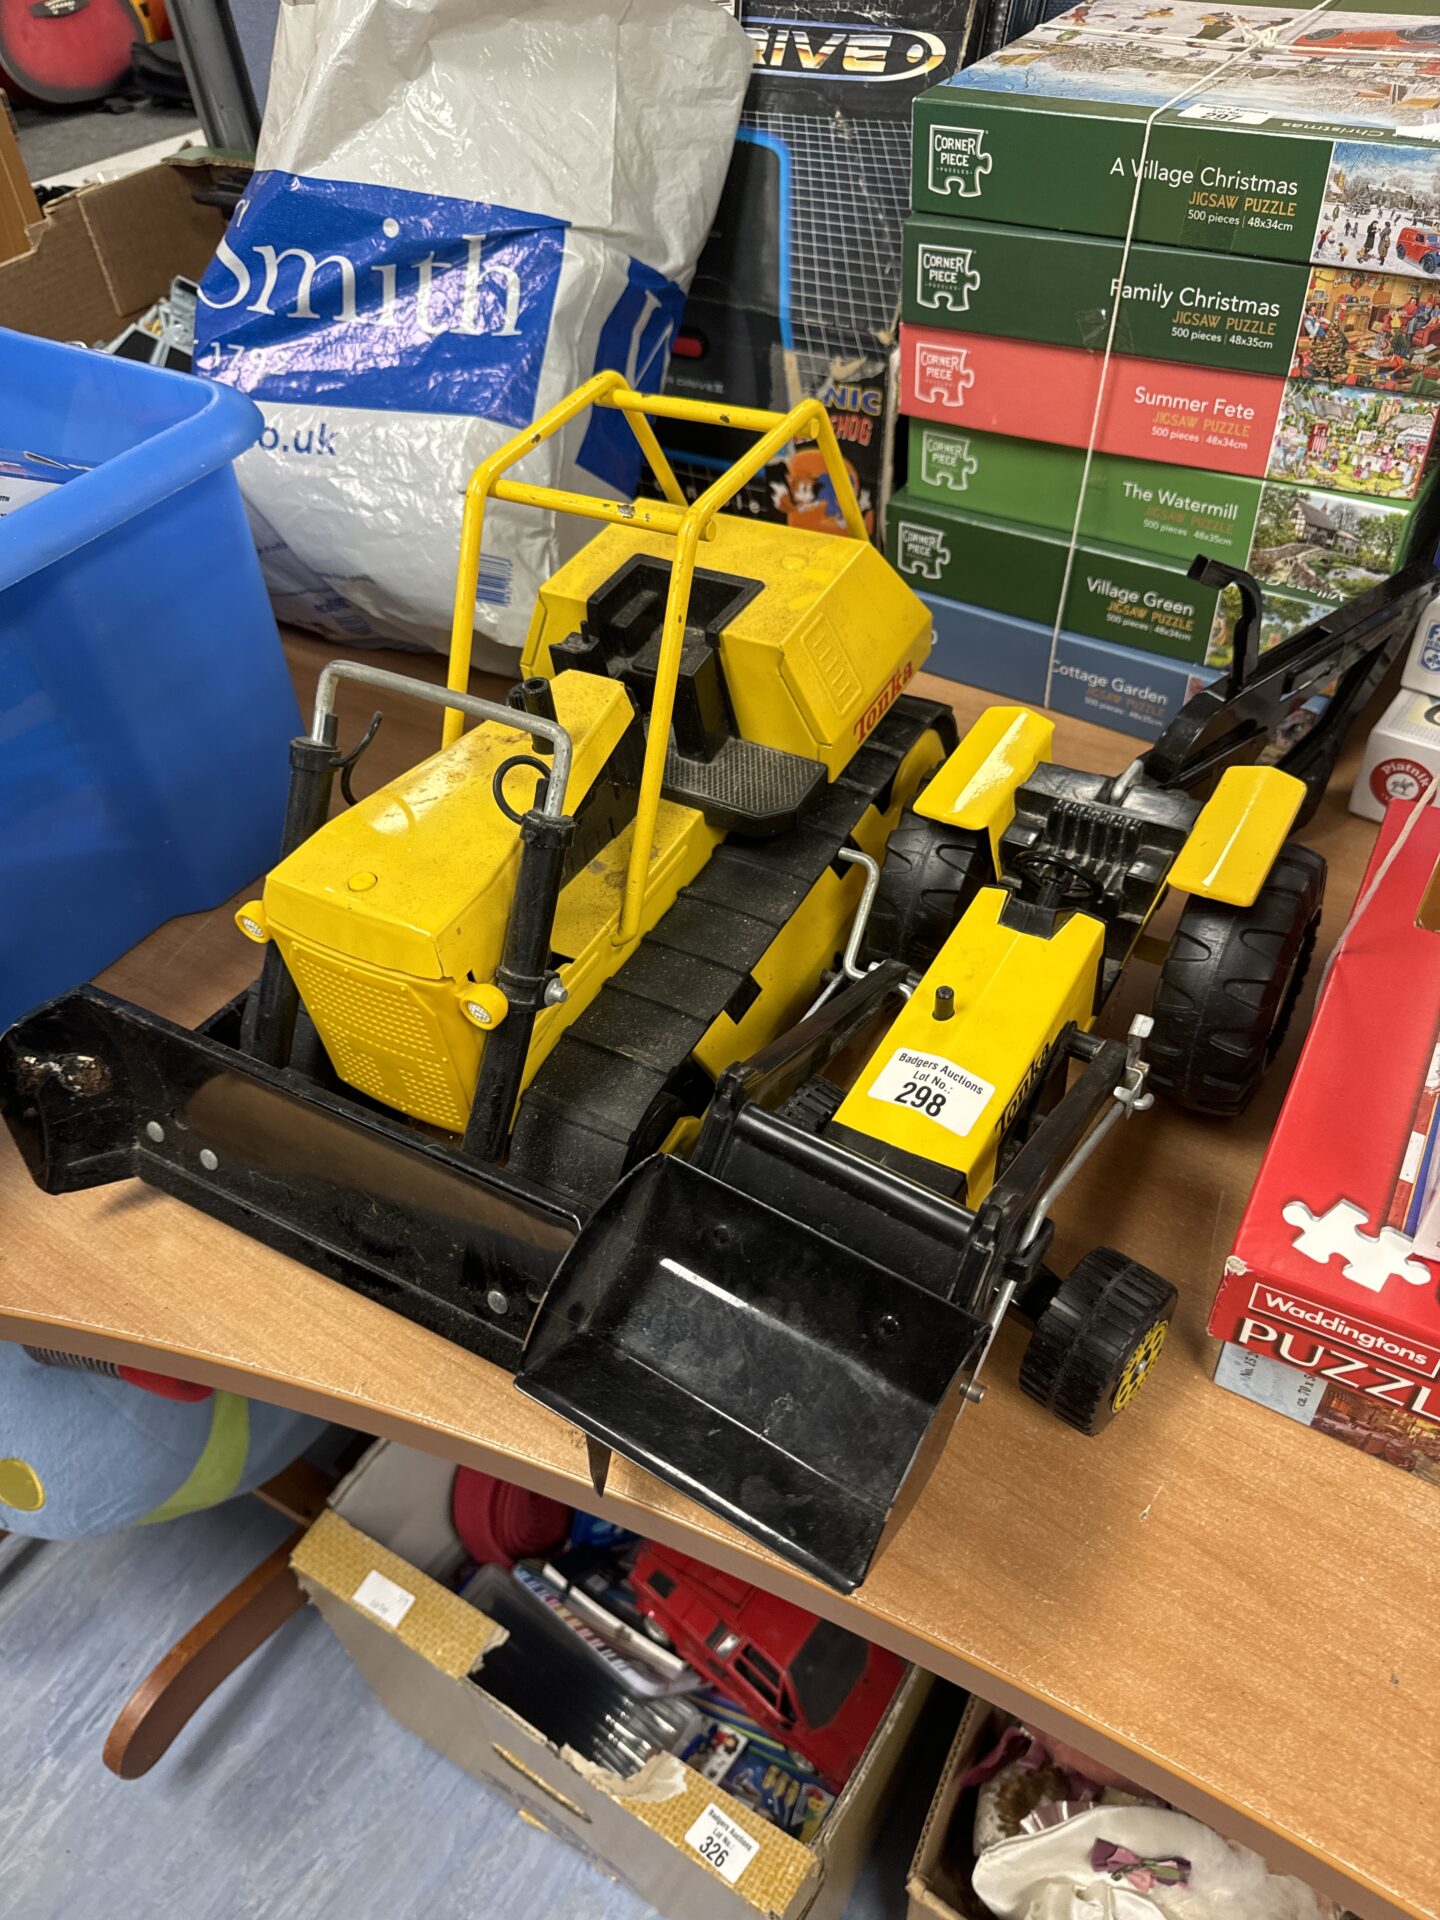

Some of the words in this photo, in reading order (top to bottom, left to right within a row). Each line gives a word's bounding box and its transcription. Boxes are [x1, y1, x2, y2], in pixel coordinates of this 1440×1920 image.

[743, 27, 893, 73] RIVE
[934, 134, 976, 156] CORNER
[940, 152, 970, 167] PIECE
[1109, 157, 1125, 177] A
[1131, 158, 1194, 188] Village
[1200, 166, 1298, 196] Christmas
[1188, 191, 1239, 209] JIGSAW
[1243, 197, 1298, 217] PUZZLE
[1187, 209, 1206, 221] 500
[1207, 212, 1240, 226] pieces
[1247, 217, 1293, 232] 48x34cm
[196, 199, 522, 337] Smith
[922, 253, 964, 274] CORNER
[928, 269, 958, 284] PIECE
[1109, 278, 1174, 308] Family
[1179, 286, 1280, 317] Christmas
[1172, 310, 1221, 329] JIGSAW
[1225, 316, 1277, 336] PUZZLE
[1170, 327, 1190, 339] 500
[1190, 330, 1222, 343] pieces
[1229, 334, 1273, 349] 48x35cm
[920, 351, 959, 372] CORNER
[925, 367, 953, 381] PIECE
[822, 382, 883, 417] NIC
[1134, 385, 1208, 413] Summer
[1213, 398, 1255, 421] Fete
[1152, 411, 1199, 429] JIGSAW
[1203, 418, 1251, 438] PUZZLE
[926, 438, 963, 460] CORNER
[1151, 426, 1168, 438] 500
[1169, 429, 1200, 443] pieces
[1205, 435, 1248, 450] 48x34cm
[931, 452, 957, 467] PIECE
[1123, 481, 1153, 502] The
[1158, 488, 1239, 521] Watermill
[902, 529, 937, 548] CORNER
[1143, 519, 1159, 530] 500
[1160, 523, 1188, 537] pieces
[907, 543, 932, 557] PIECE
[1086, 576, 1139, 604] Village
[1143, 592, 1195, 617] Green
[1106, 601, 1148, 619] JIGSAW
[1151, 610, 1195, 631] PUZZLE
[1106, 613, 1121, 624] 500
[1122, 617, 1148, 631] pieces
[853, 660, 912, 745] Tonka
[1111, 677, 1168, 706] Garden
[898, 1052, 939, 1071] Badgers
[940, 1065, 984, 1096] Auctions
[912, 1070, 929, 1083] Lot
[894, 1081, 947, 1117] 298
[1265, 1292, 1429, 1366] Waddingtons
[708, 1808, 730, 1831] Badgers
[729, 1827, 753, 1852] Auctions
[712, 1827, 723, 1840] Lot
[699, 1835, 729, 1868] 326
